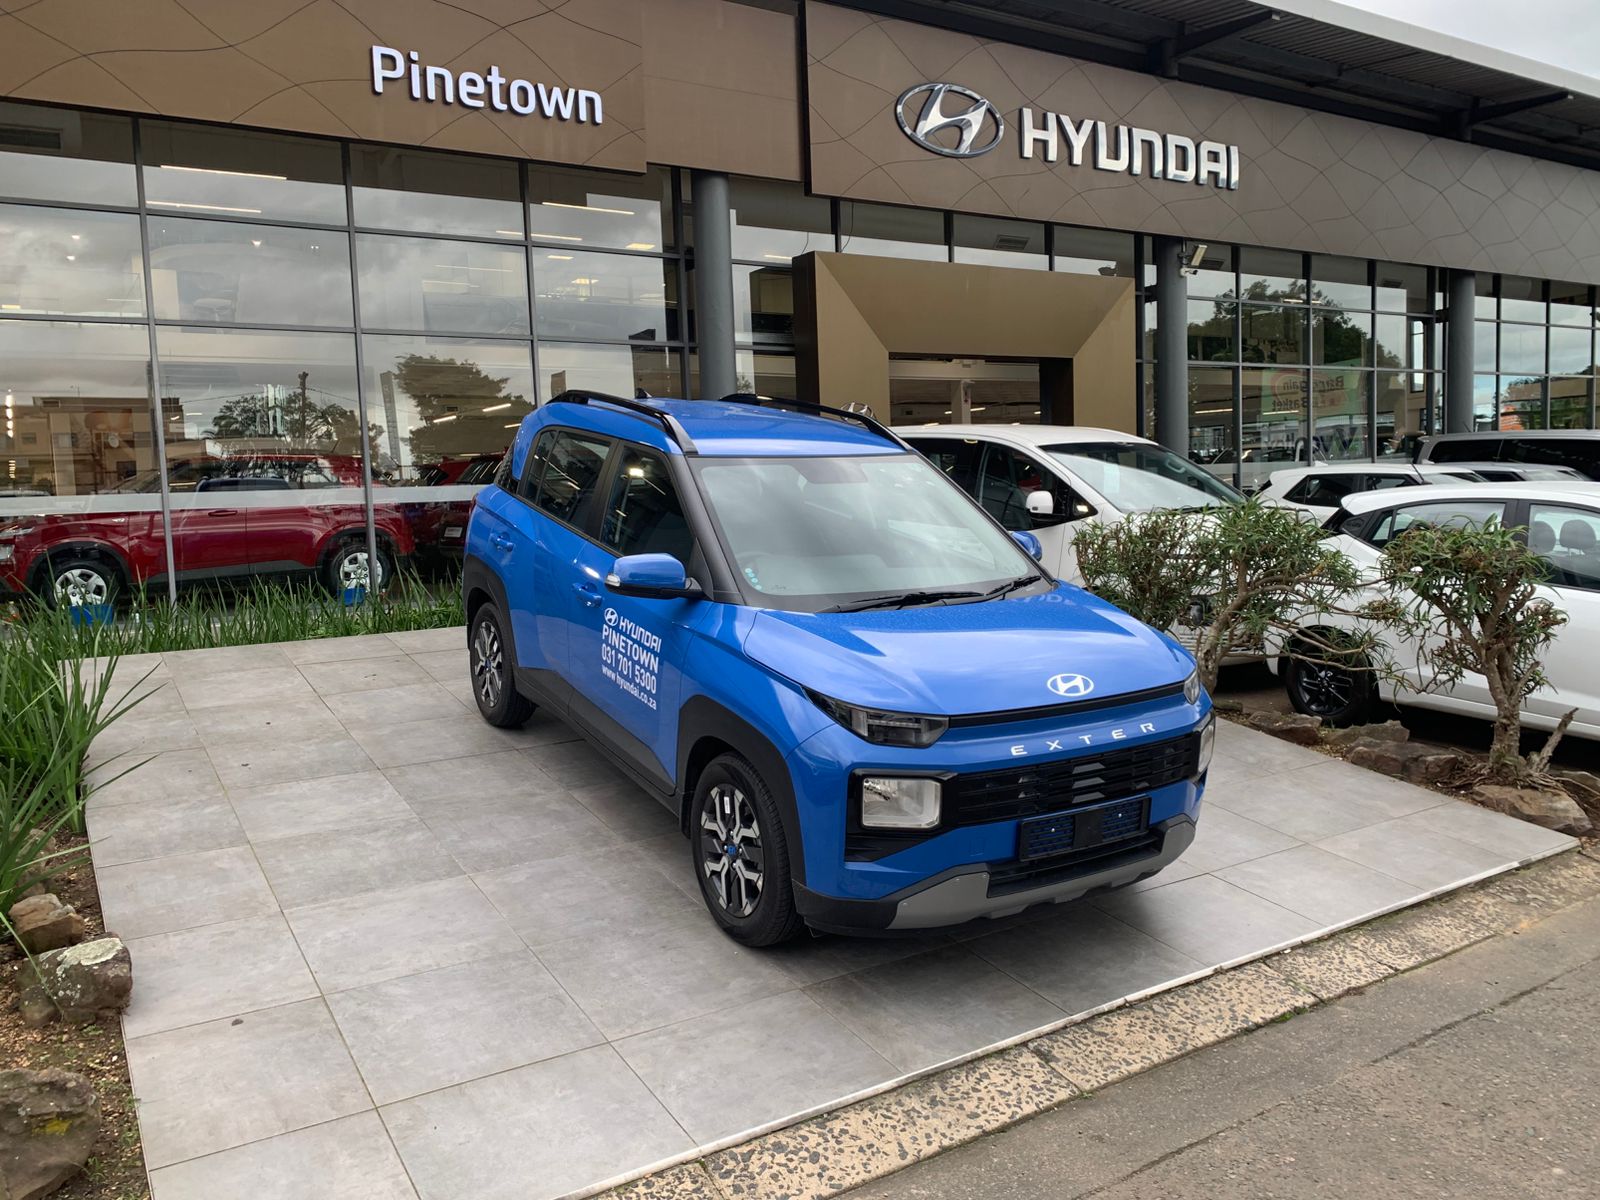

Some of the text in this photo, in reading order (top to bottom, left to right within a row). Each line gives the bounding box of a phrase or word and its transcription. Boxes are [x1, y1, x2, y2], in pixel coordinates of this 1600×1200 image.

[371, 45, 603, 124] Pinetown
[1020, 107, 1240, 190] HYUNDAI
[602, 624, 659, 674] PINETOWN
[619, 616, 662, 653] HYUNDAI
[602, 643, 657, 694] 031 701 5300
[1010, 722, 1156, 756] EXTER
